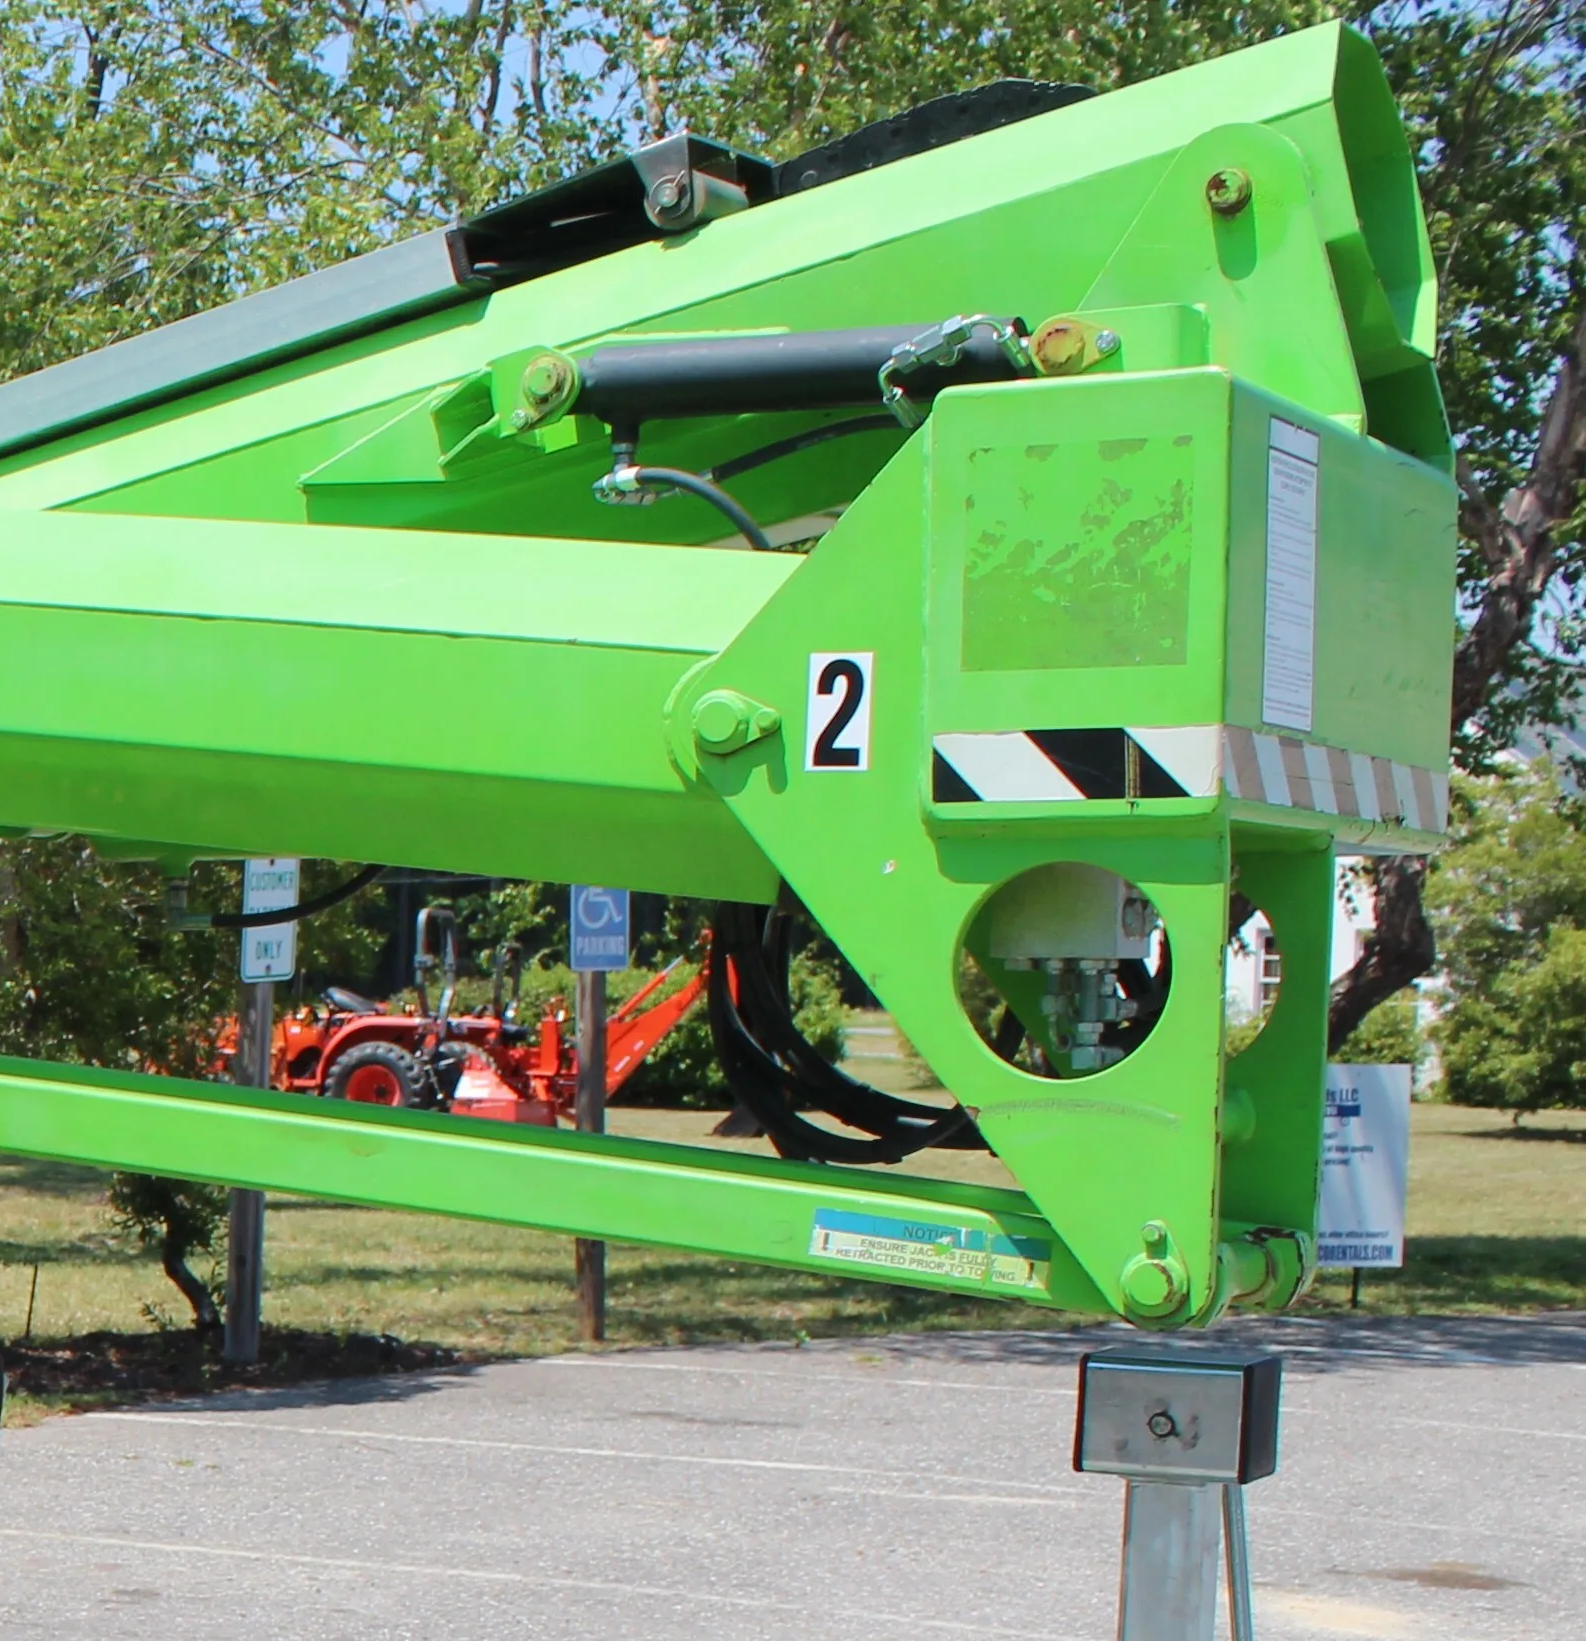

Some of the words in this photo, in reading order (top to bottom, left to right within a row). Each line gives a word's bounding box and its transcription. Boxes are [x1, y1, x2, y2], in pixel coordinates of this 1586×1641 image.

[811, 658, 865, 767] 2
[256, 940, 284, 960] ONLY
[860, 1238, 910, 1254] ENSURE
[835, 1247, 906, 1266] RETRACTED
[908, 1256, 945, 1271] PRIOR
[949, 1263, 967, 1275] TO
[967, 1266, 1016, 1282] TOING
